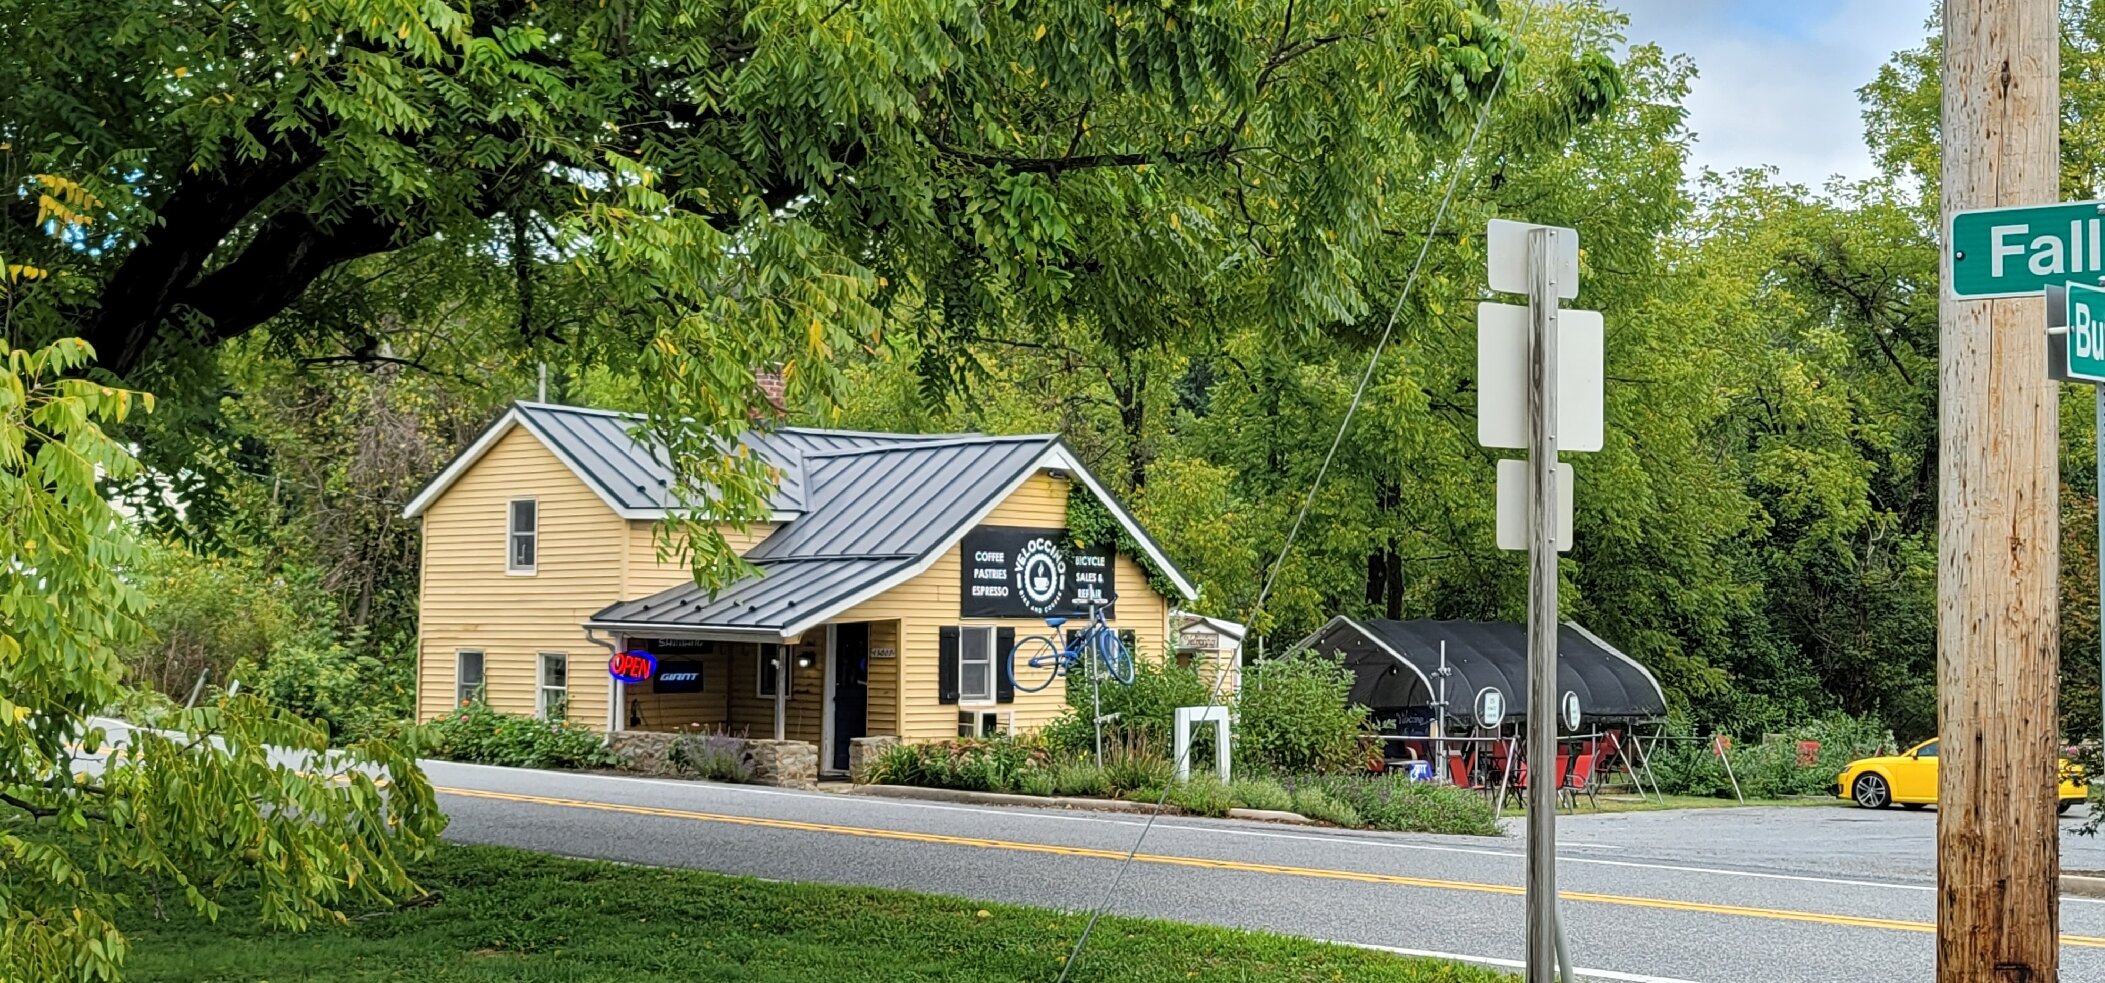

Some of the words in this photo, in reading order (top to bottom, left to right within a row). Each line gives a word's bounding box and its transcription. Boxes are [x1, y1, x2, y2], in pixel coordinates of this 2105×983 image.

[2075, 302, 2105, 361] Bu
[975, 551, 1005, 562] COFFEE
[1014, 537, 1066, 574] VELOCCINO
[1075, 556, 1106, 567] BICYCLE
[973, 568, 1007, 579] PASTRIES
[1075, 572, 1097, 583] SALES
[972, 585, 1009, 597] ESPRESSO
[611, 653, 652, 680] OPEN
[660, 672, 700, 681] GIANT
